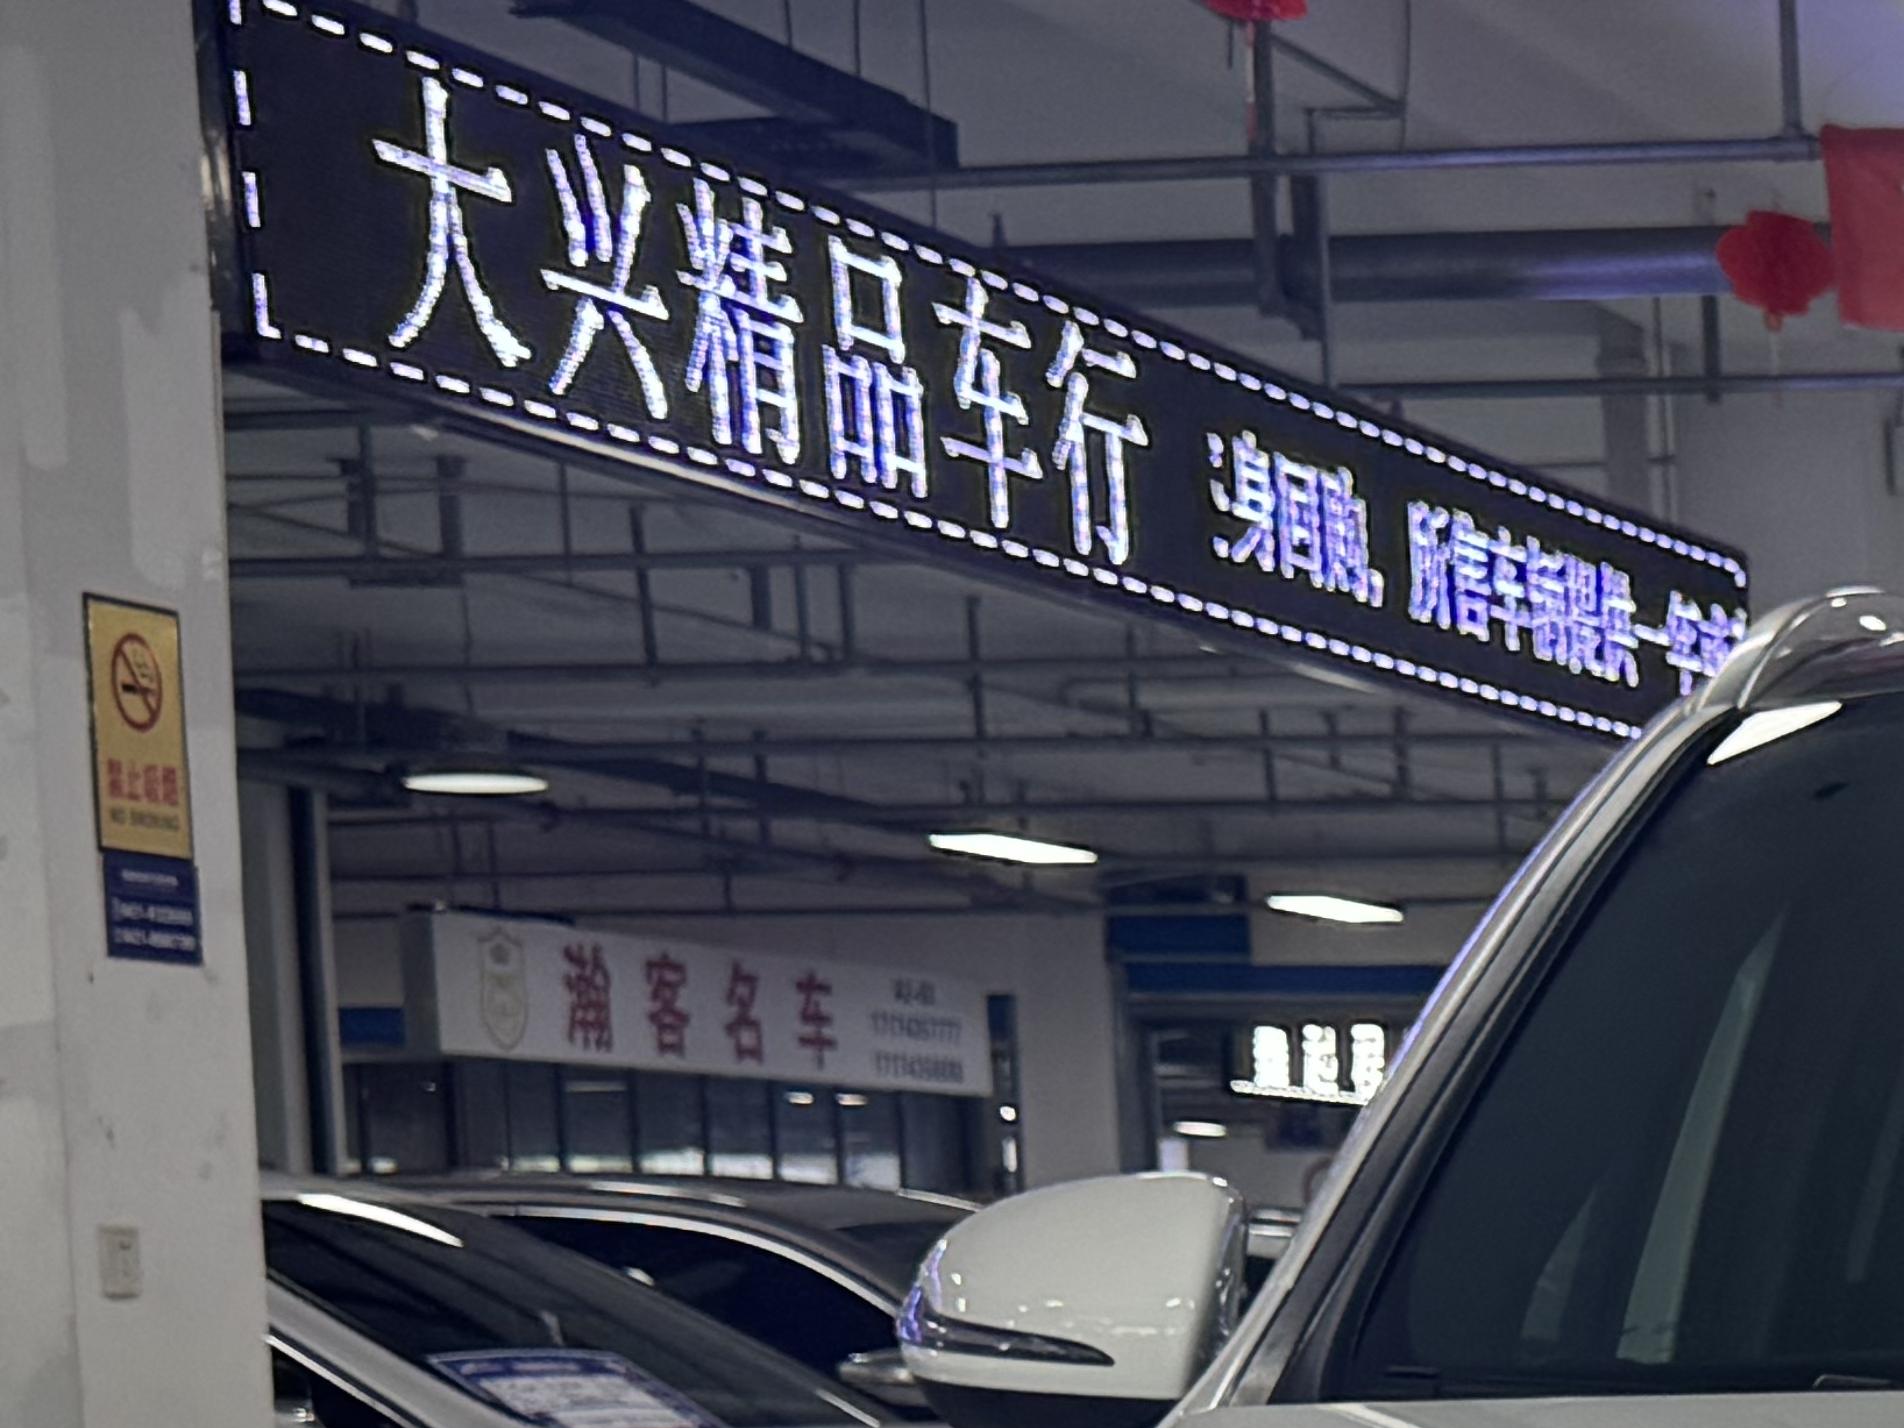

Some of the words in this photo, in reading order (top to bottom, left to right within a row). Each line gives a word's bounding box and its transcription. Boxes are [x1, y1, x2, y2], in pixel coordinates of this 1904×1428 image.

[372, 75, 1149, 565] 大兴精品车行
